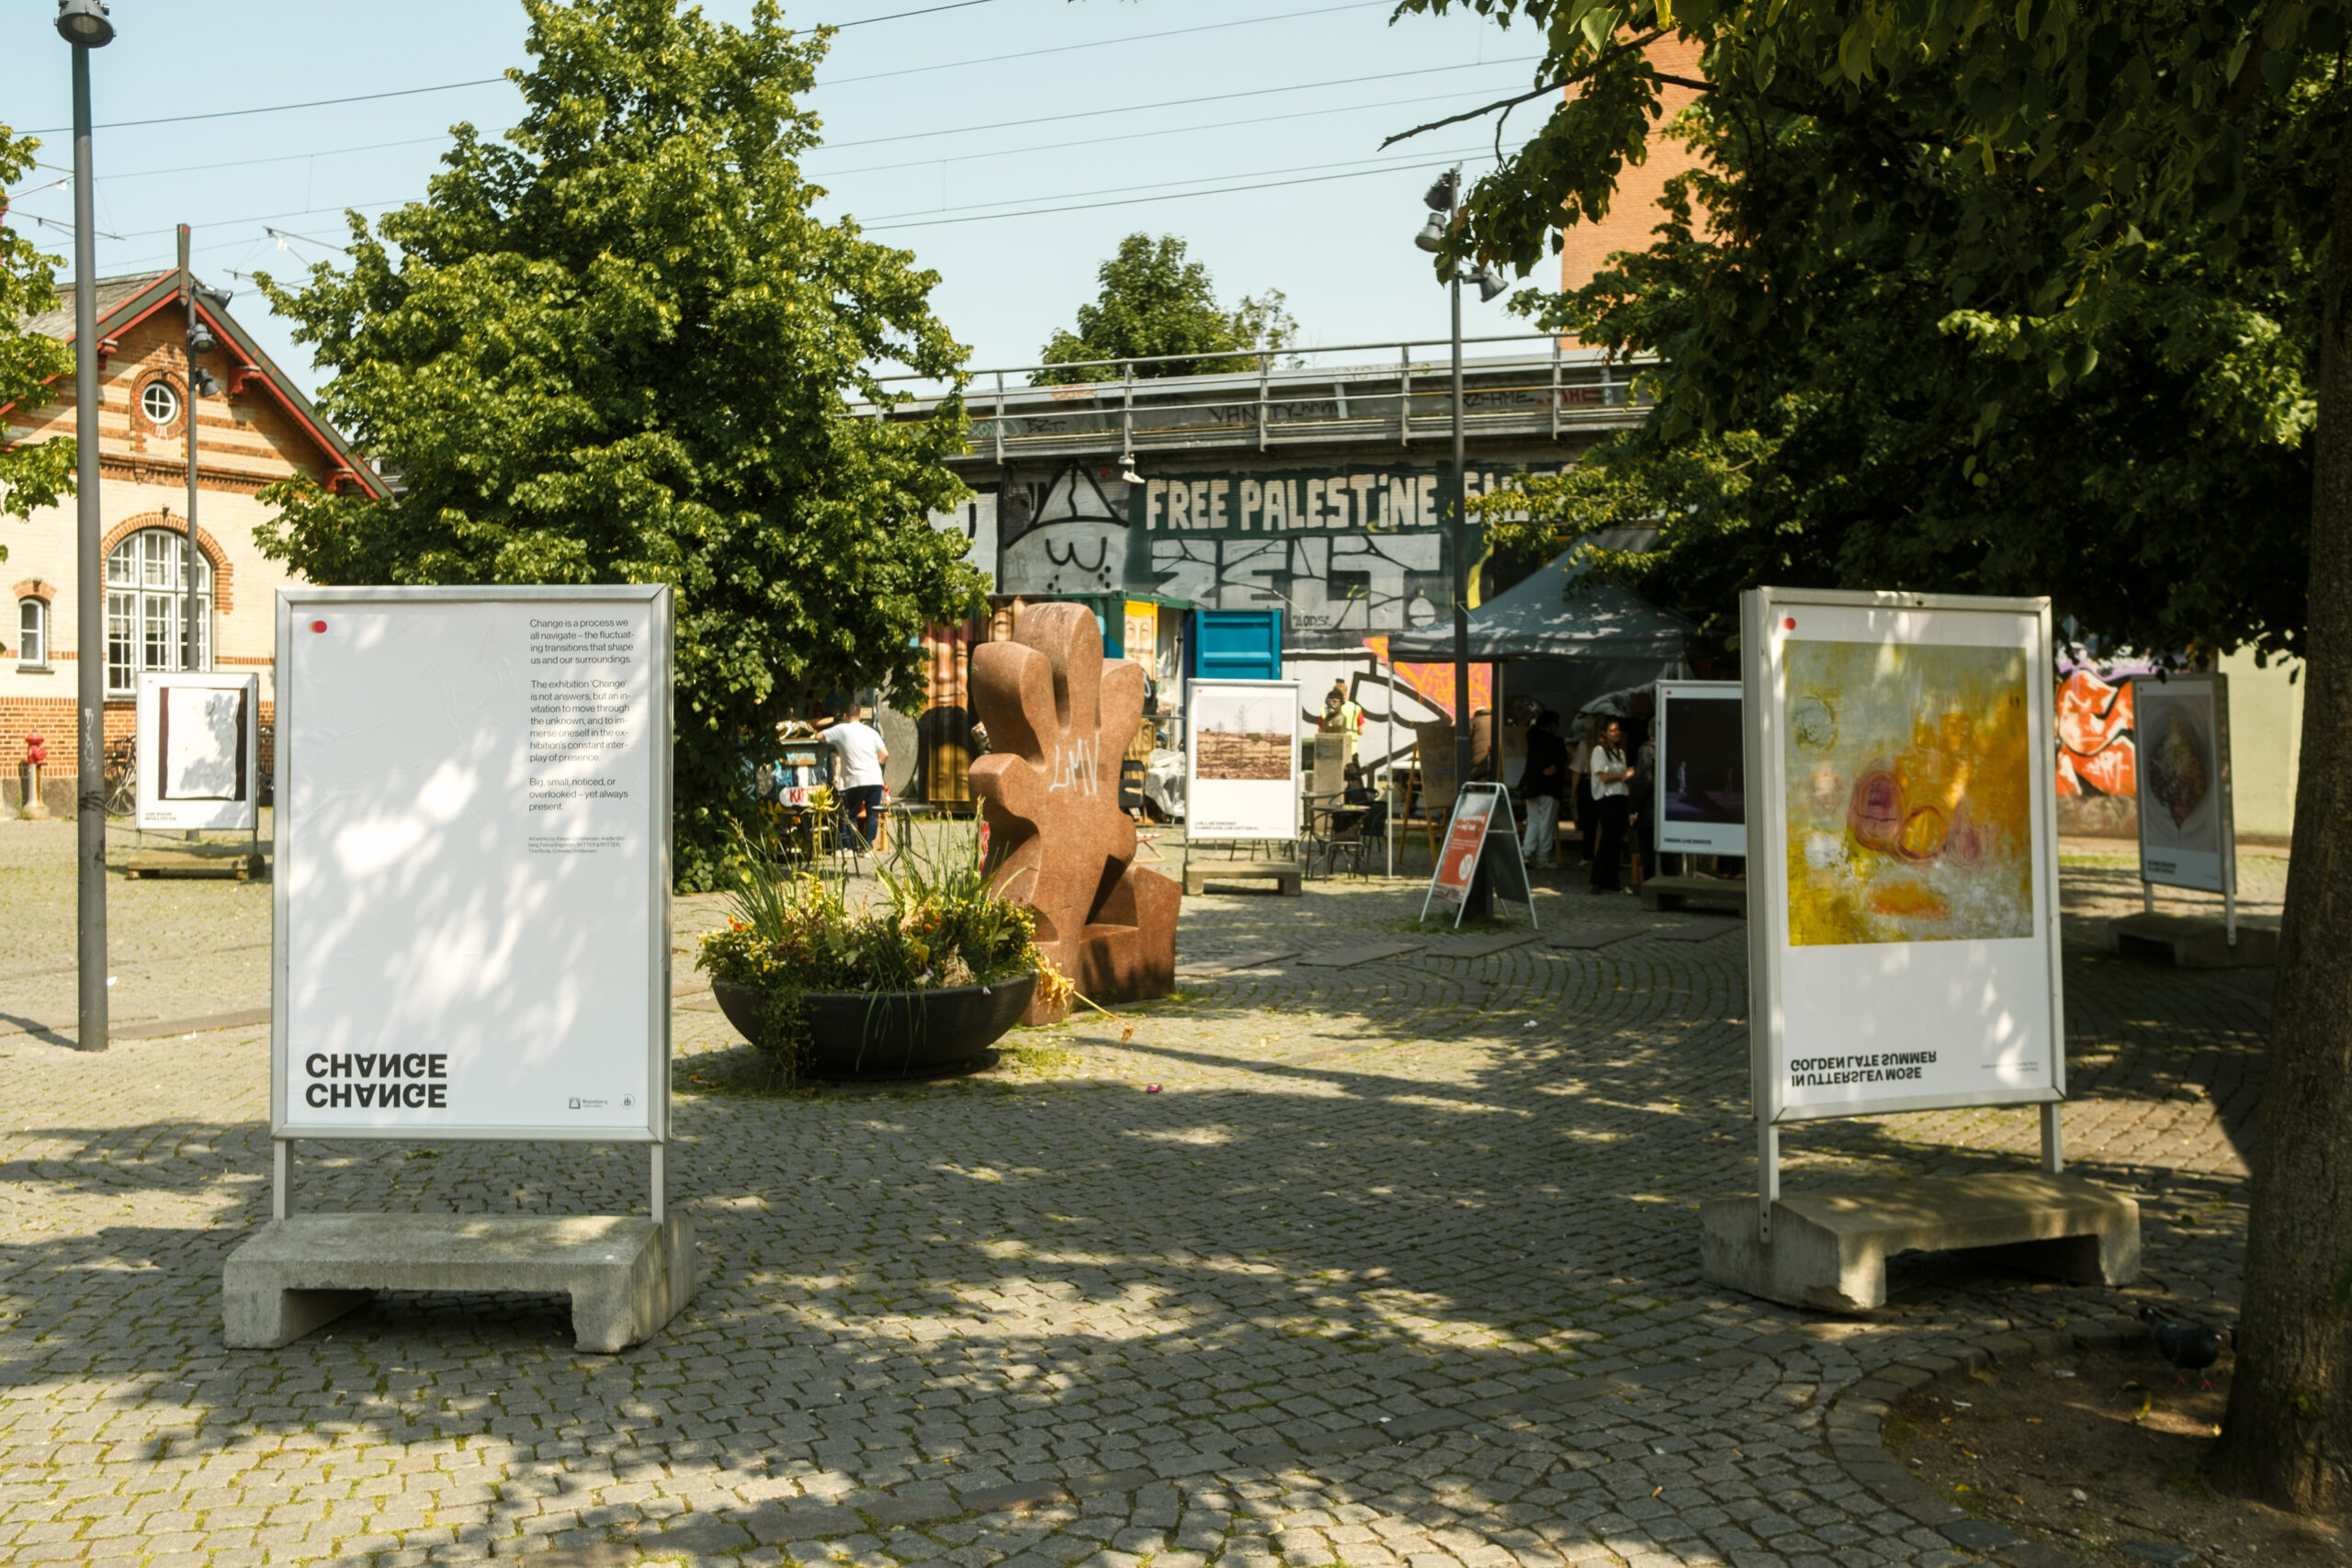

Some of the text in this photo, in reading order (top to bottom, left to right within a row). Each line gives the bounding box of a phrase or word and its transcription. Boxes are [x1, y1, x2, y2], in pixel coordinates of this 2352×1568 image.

[1146, 479, 1229, 531] FREE
[529, 618, 564, 629] Change
[565, 619, 571, 627] is
[580, 620, 615, 628] process
[529, 632, 539, 640] all
[540, 631, 577, 641] navigate
[584, 631, 599, 639] the
[530, 643, 634, 654] ing transitions that shape
[542, 656, 559, 664] and
[530, 680, 548, 689] The
[548, 680, 589, 688] exhibition
[530, 693, 537, 701] is
[538, 693, 552, 701] not
[593, 692, 606, 701] but
[530, 705, 561, 713] vitation
[562, 705, 571, 713] to
[596, 704, 630, 714] through
[530, 717, 544, 726] the
[587, 716, 604, 725] and
[605, 716, 614, 725] to
[558, 728, 590, 738] oneself
[591, 728, 599, 737] in
[600, 728, 614, 737] the
[567, 741, 605, 750] constant
[529, 753, 548, 763] play
[548, 753, 558, 762] of
[528, 790, 577, 799] overlooked
[584, 791, 597, 800] yet
[599, 790, 628, 800] always
